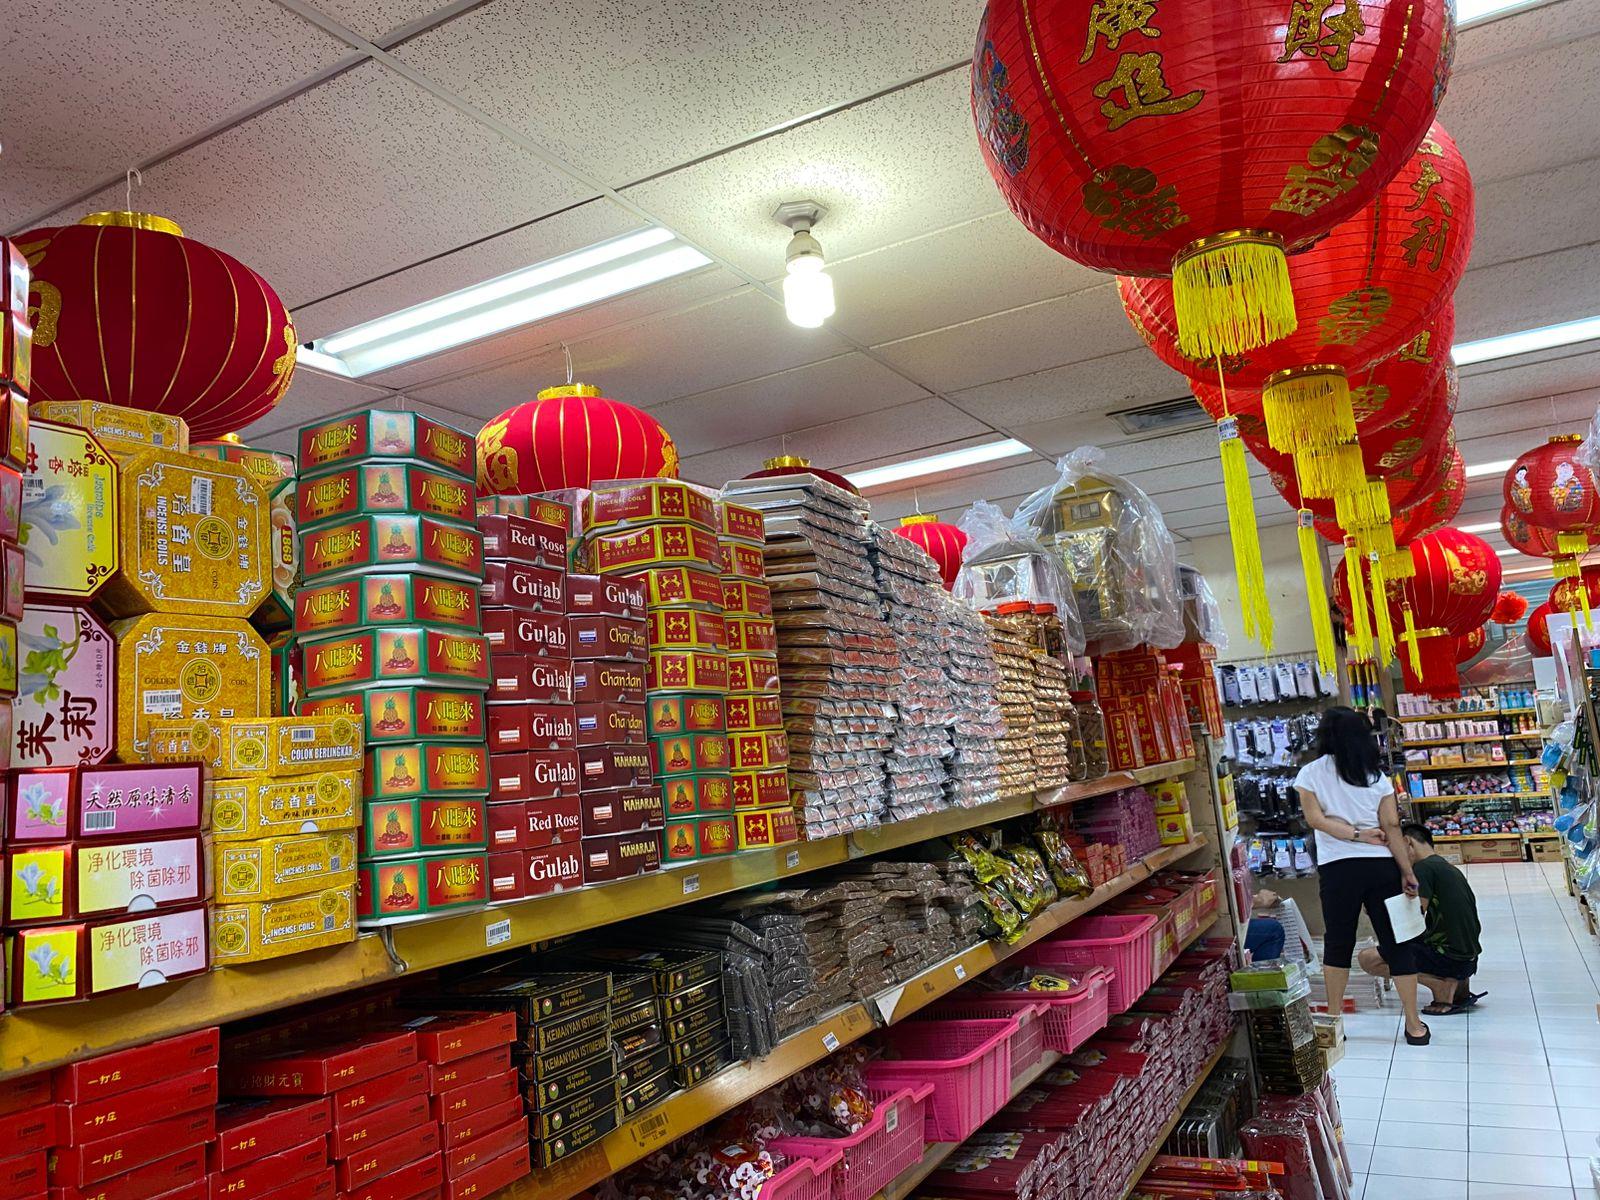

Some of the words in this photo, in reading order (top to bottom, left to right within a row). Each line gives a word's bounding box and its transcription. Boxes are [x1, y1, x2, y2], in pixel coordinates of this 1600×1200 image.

[156, 496, 168, 542] INCENSE
[281, 527, 293, 564] 1868
[510, 529, 536, 548] Red
[538, 535, 565, 554] Rose
[157, 542, 169, 566] COILS
[605, 585, 643, 607] Gulab
[518, 622, 566, 646] Gulab
[145, 677, 176, 685] GOLDEN
[532, 667, 572, 689] Gulab
[600, 671, 642, 688] Chandan
[16, 690, 98, 766] 茉莉
[532, 717, 572, 737] Gulab
[609, 713, 643, 729] Chandan
[291, 748, 314, 761] COLOK
[613, 755, 649, 768] MAHARAJA
[534, 762, 576, 784] Gulab
[85, 785, 194, 811] 天然原味清香
[623, 797, 661, 812] MAHARAJA
[528, 815, 552, 832] Red
[554, 813, 579, 828] Rose
[620, 841, 656, 858] MAHARAJA
[129, 864, 191, 891] 除菌除邪
[282, 865, 306, 877] INCENSE
[307, 862, 323, 872] COILS
[529, 855, 579, 881] Gulab
[270, 925, 297, 937] INCENSE
[298, 922, 316, 931] COILS
[139, 936, 200, 967] 除菌除邪
[546, 1021, 581, 1043] KEMANYAN
[581, 1009, 608, 1029] ISTIMEWA
[544, 1049, 581, 1072] KEMANYAN
[580, 1036, 607, 1057] ISTIMEWA
